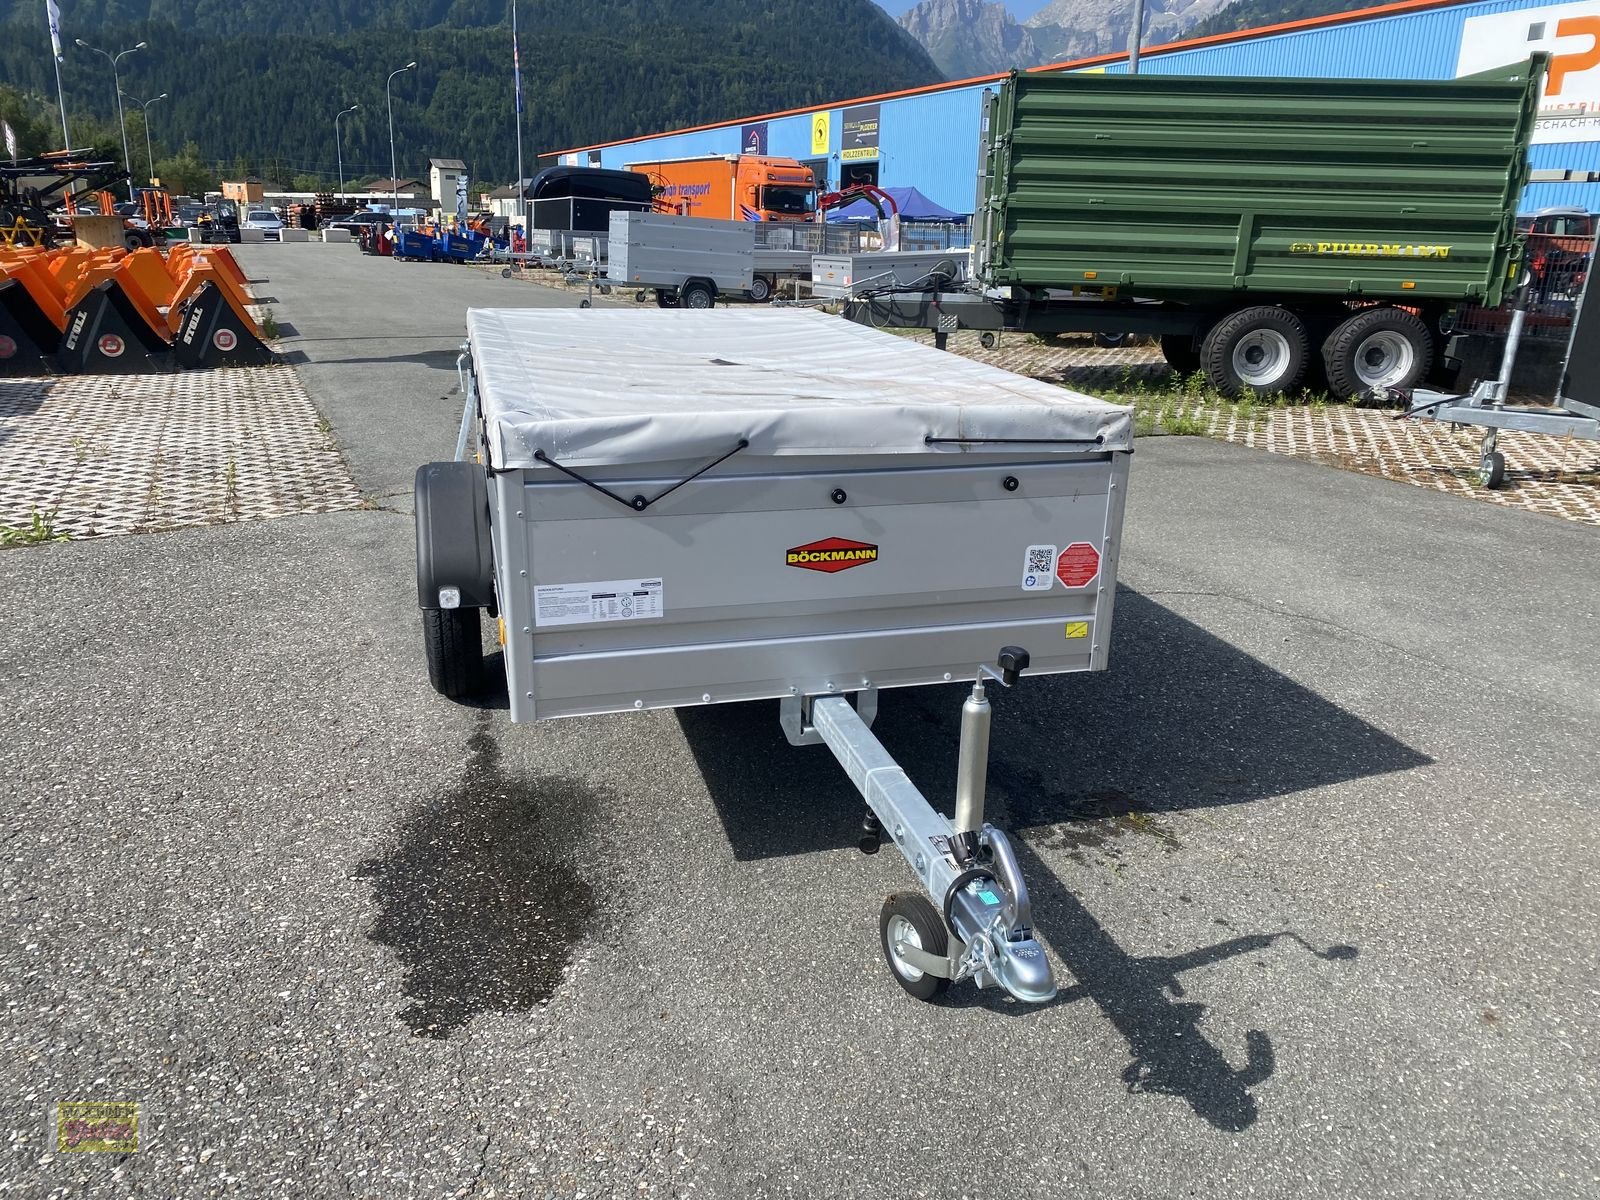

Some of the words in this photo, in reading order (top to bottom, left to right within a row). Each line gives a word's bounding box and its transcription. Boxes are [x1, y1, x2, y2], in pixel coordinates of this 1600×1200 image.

[842, 148, 878, 160] HOLZZENTRUM
[679, 182, 711, 199] transport
[1316, 242, 1450, 259] FUHRMANN
[66, 310, 88, 350] STOLL
[183, 307, 203, 345] STOLL
[787, 549, 877, 564] BÖCKMANN
